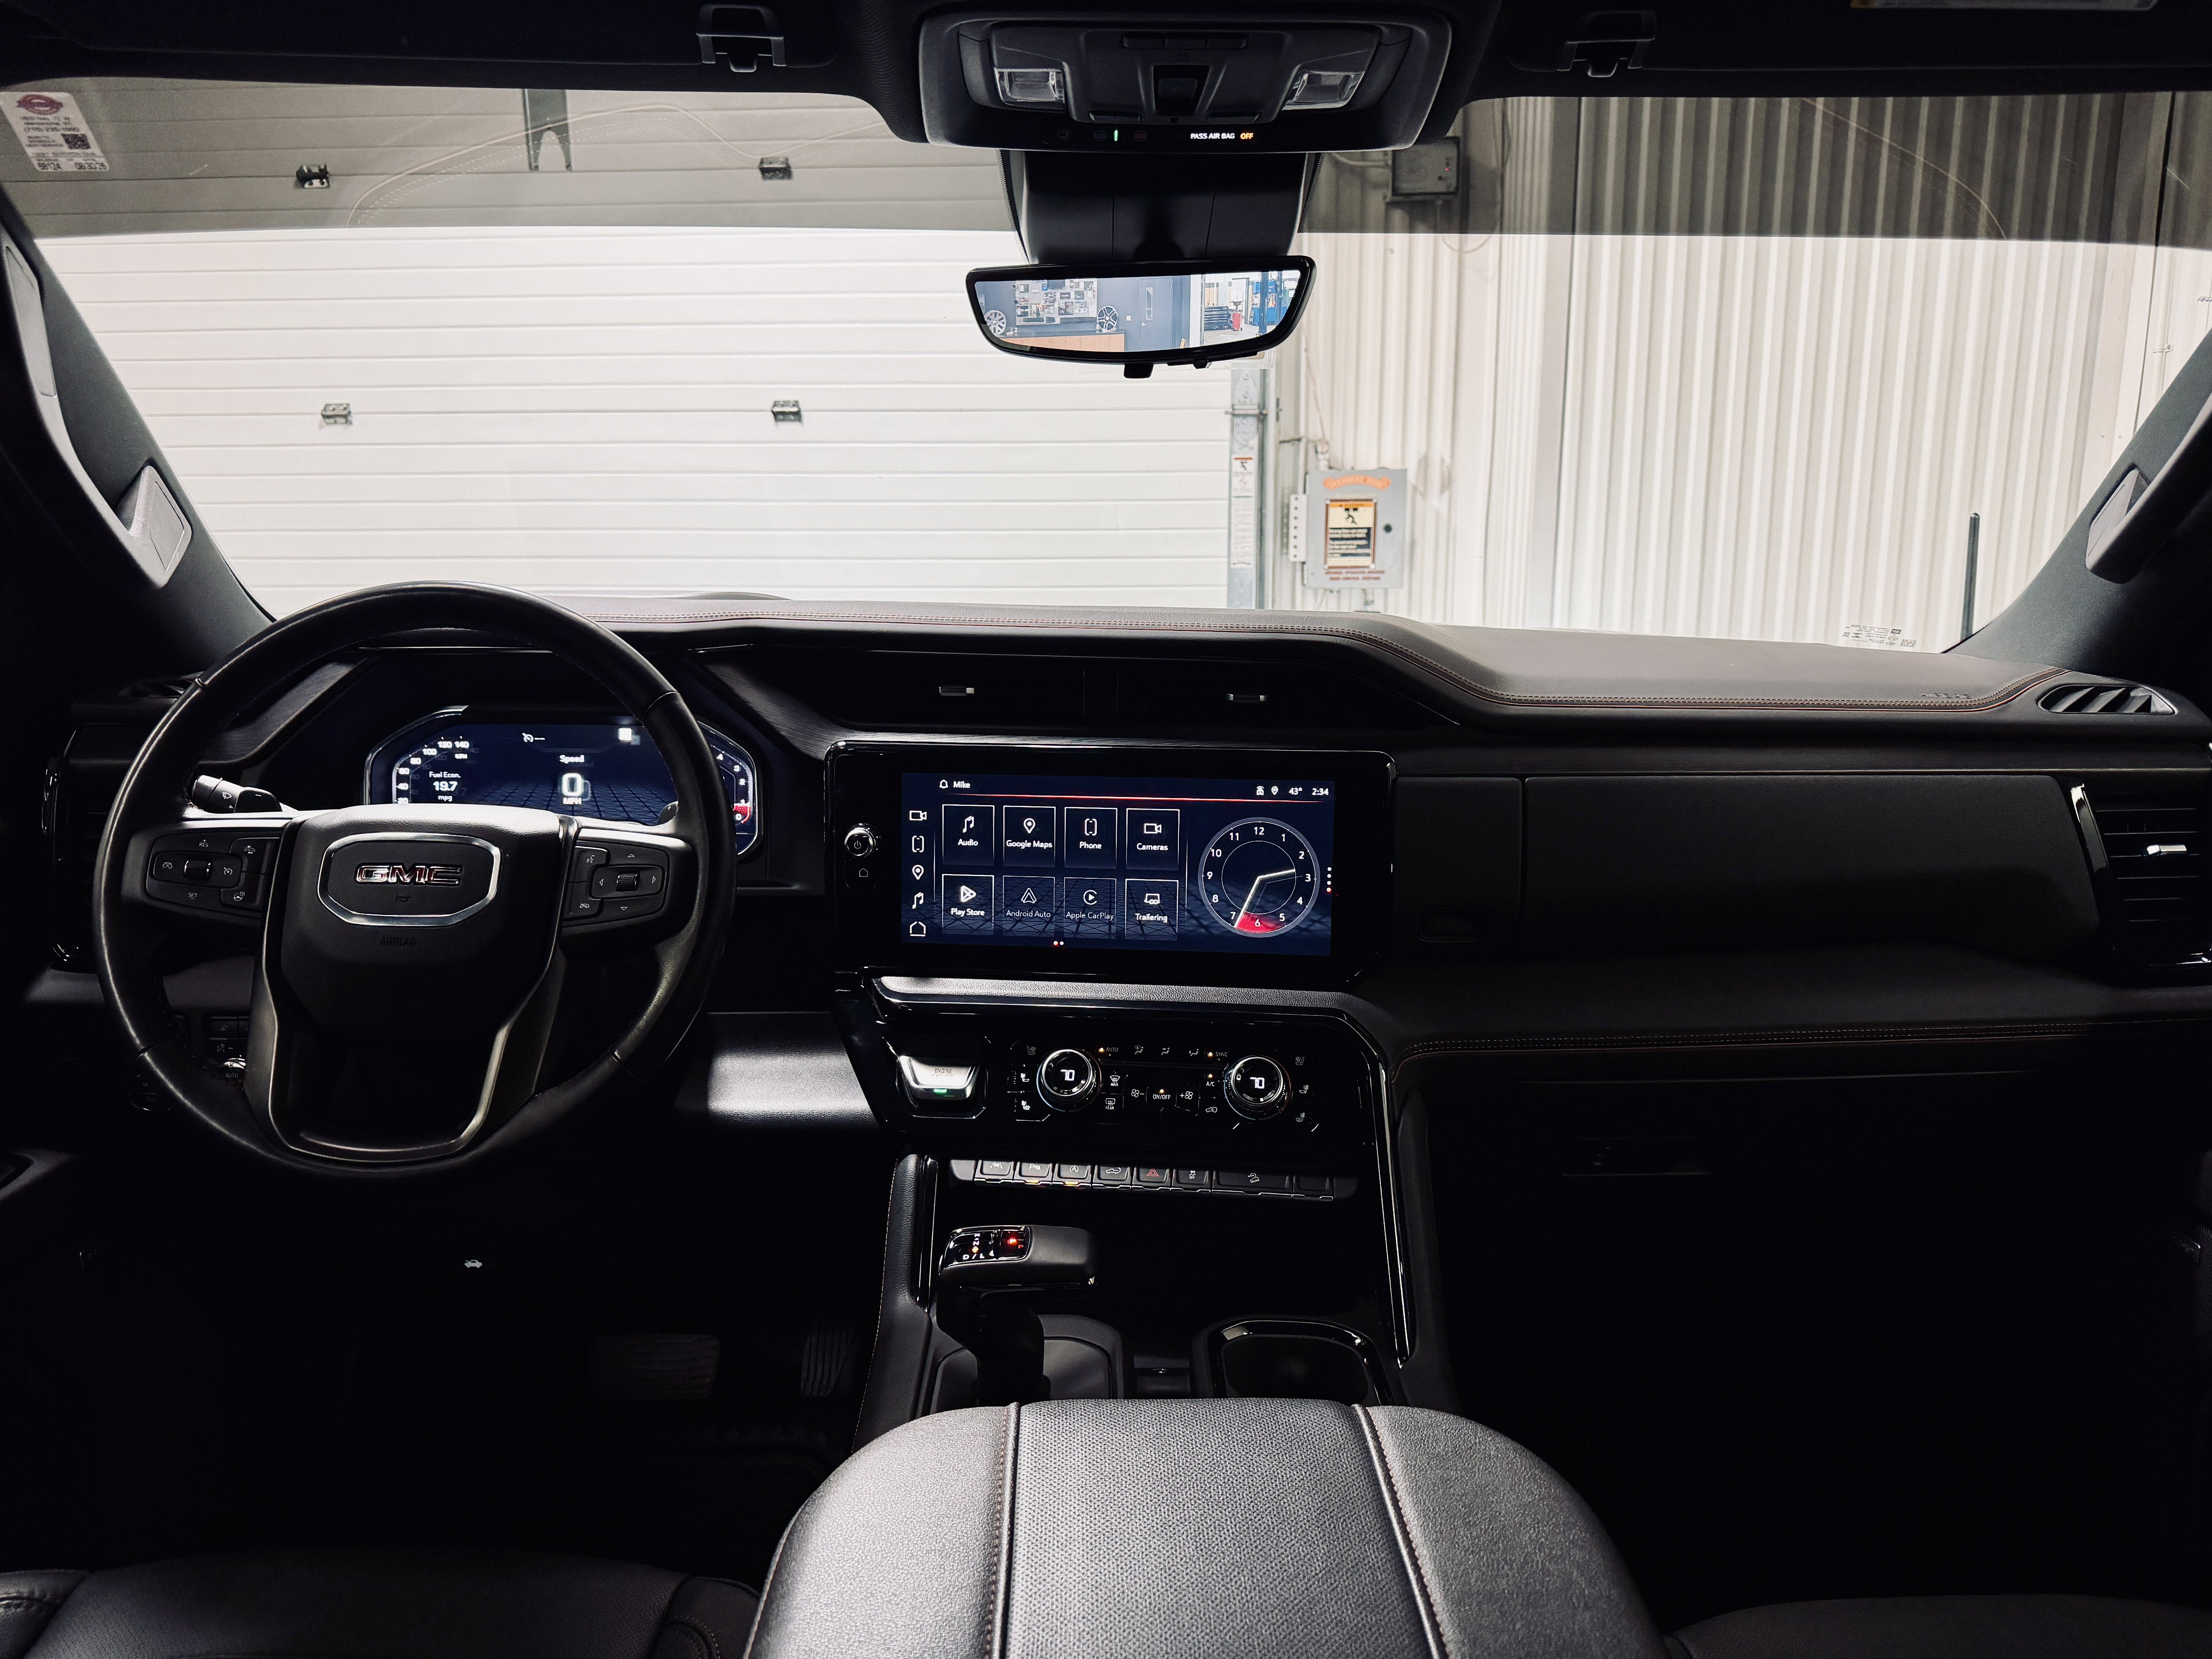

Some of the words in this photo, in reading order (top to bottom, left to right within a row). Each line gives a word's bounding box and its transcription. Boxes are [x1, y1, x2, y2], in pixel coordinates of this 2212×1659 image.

[559, 755, 584, 764] Speed
[433, 781, 457, 791] 19.7
[562, 773, 582, 796] 0
[1254, 827, 1264, 835] 12
[1230, 833, 1239, 841] 11
[1281, 833, 1285, 842] 1
[1006, 840, 1031, 849] Google
[1033, 841, 1053, 849] Maps
[1137, 843, 1168, 851] Cameras
[1211, 849, 1222, 857] 10
[356, 864, 462, 886] GMC
[1305, 874, 1311, 882] 3
[1212, 895, 1219, 903] 8
[1297, 896, 1303, 905] 4
[951, 908, 965, 917] Play
[1066, 912, 1085, 920] Apple
[1088, 912, 1114, 921] CarPlay
[1230, 912, 1236, 920] 7
[1135, 913, 1168, 922] Trailering
[1279, 913, 1285, 922] 5
[1255, 919, 1261, 927] 6
[1060, 1069, 1075, 1081] 70
[1250, 1077, 1265, 1089] 70
